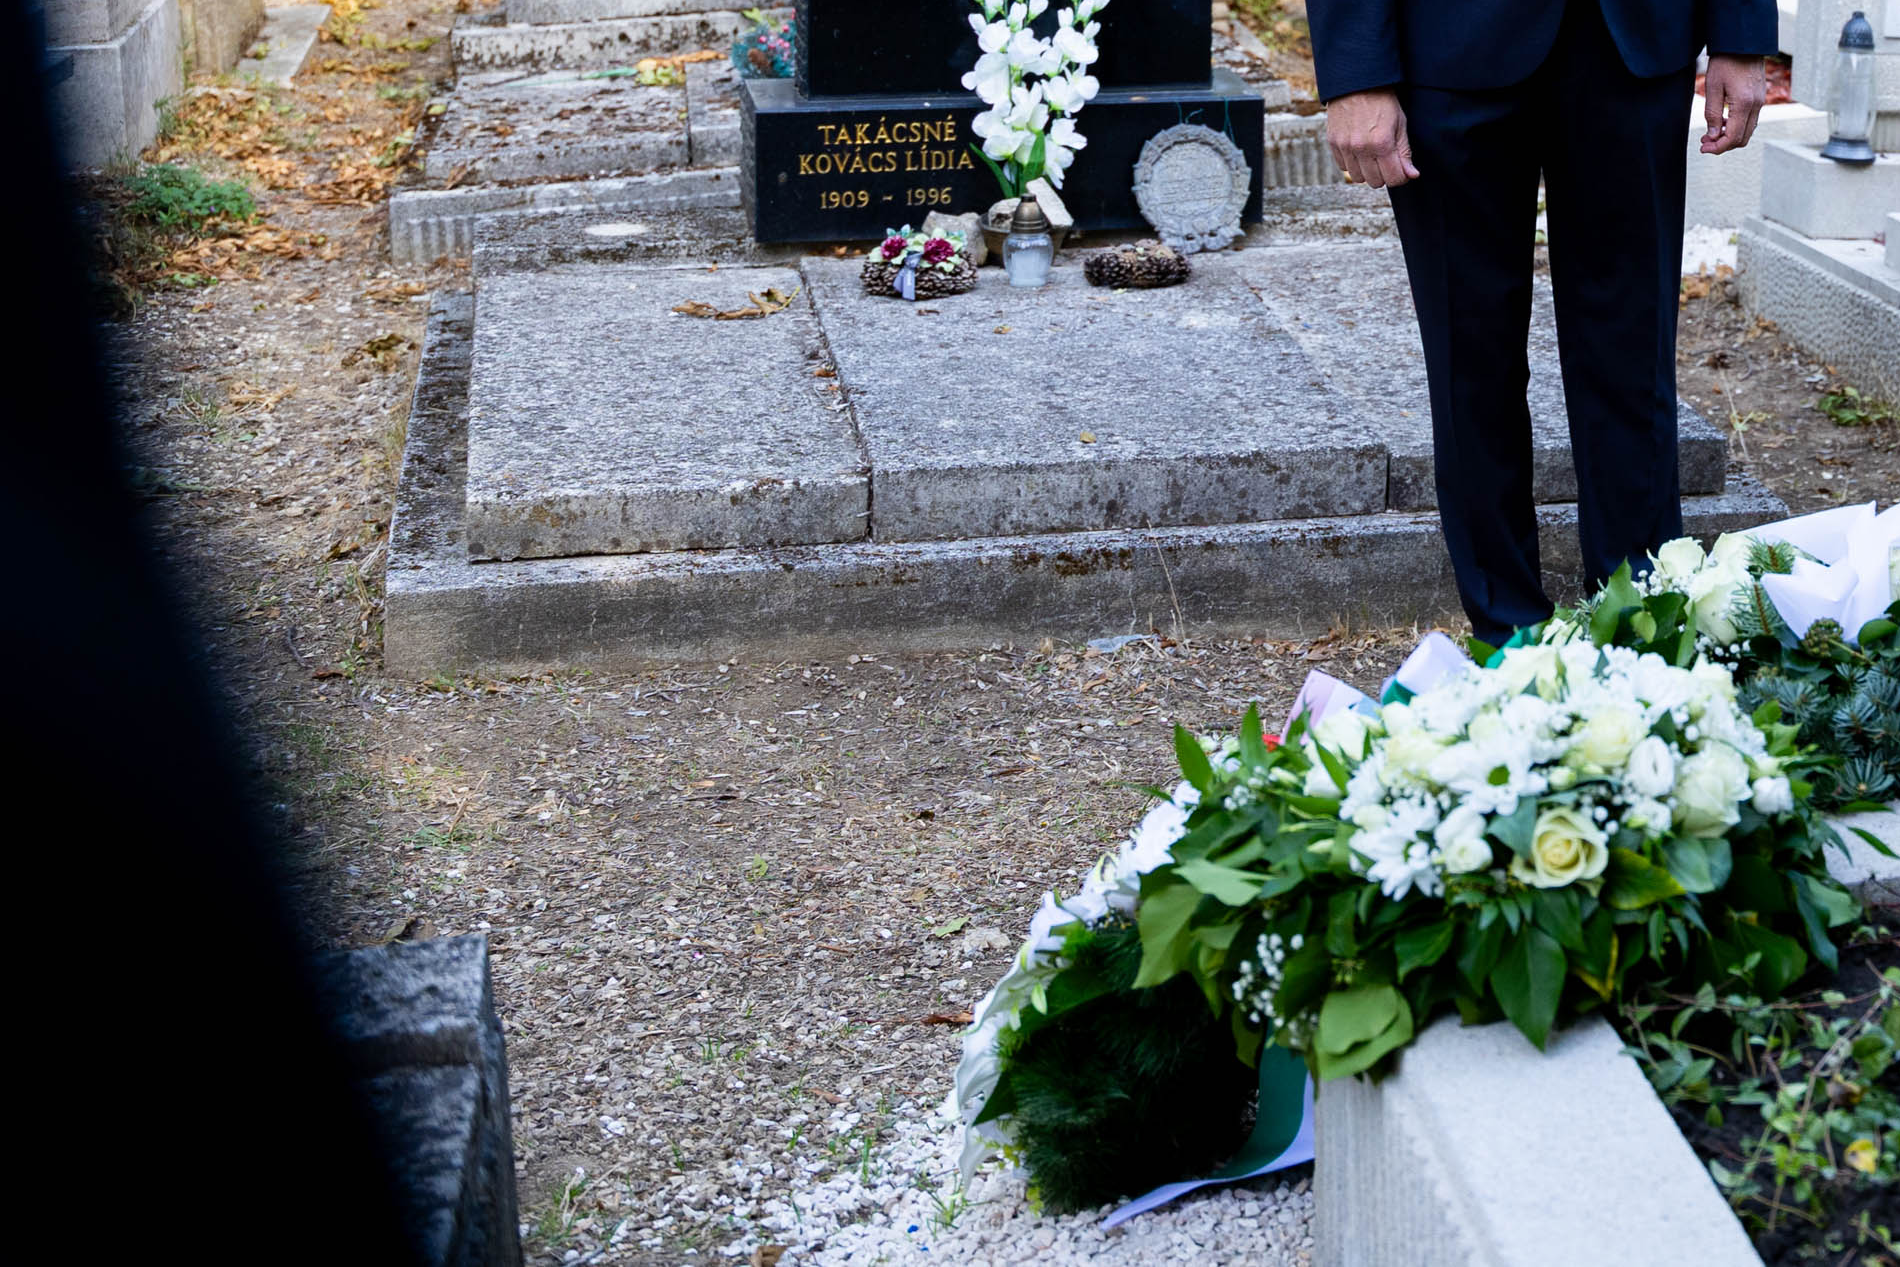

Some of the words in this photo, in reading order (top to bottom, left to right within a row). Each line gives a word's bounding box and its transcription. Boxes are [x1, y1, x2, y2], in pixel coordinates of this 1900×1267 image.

[817, 114, 957, 146] TAKÁCSNÉ
[797, 145, 898, 175] KOVÁCS
[904, 144, 976, 171] LÍDIA
[819, 190, 870, 210] 1909
[905, 186, 953, 206] 1996
